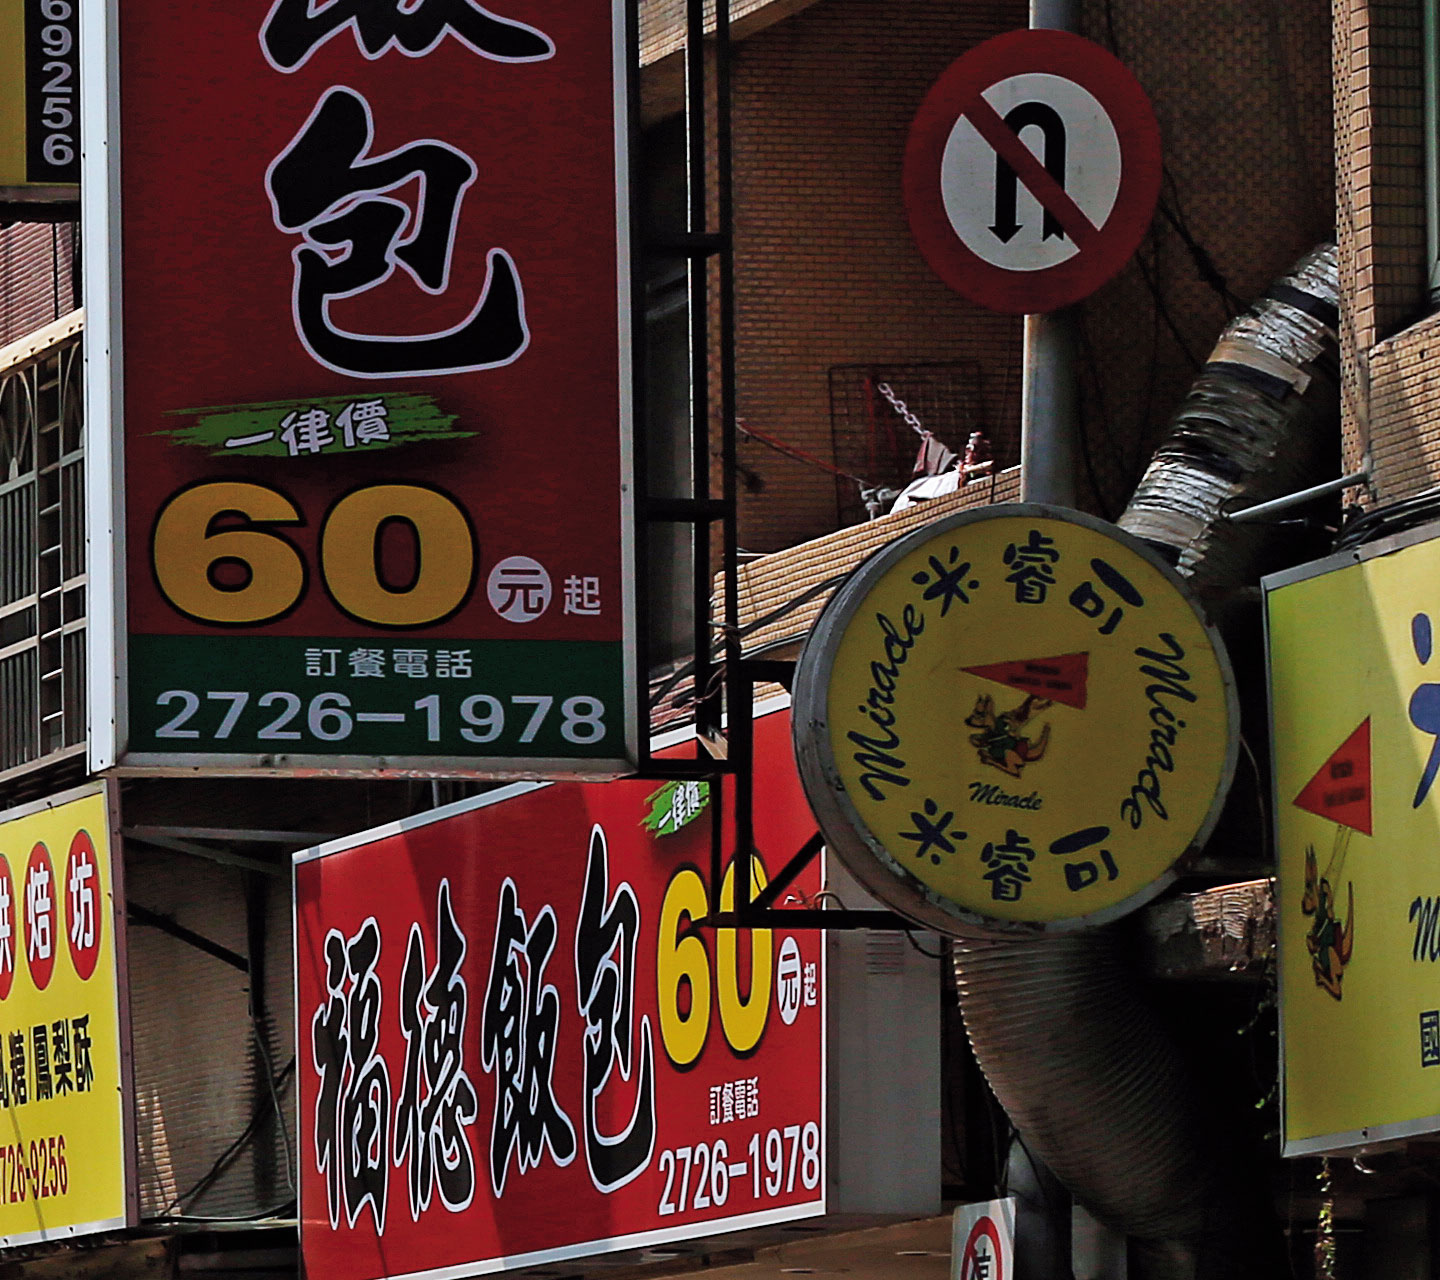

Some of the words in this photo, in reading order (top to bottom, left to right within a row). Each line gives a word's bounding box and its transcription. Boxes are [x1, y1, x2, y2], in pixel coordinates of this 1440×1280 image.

[224, 398, 391, 458] 一律價
[150, 477, 479, 629] 60
[304, 648, 474, 681] 訂餐電話
[153, 689, 608, 745] 2726-1978
[312, 822, 657, 1237] 福德飯包
[709, 1075, 760, 1126] 訂餐電話
[657, 1120, 821, 1216] 2726-1978
